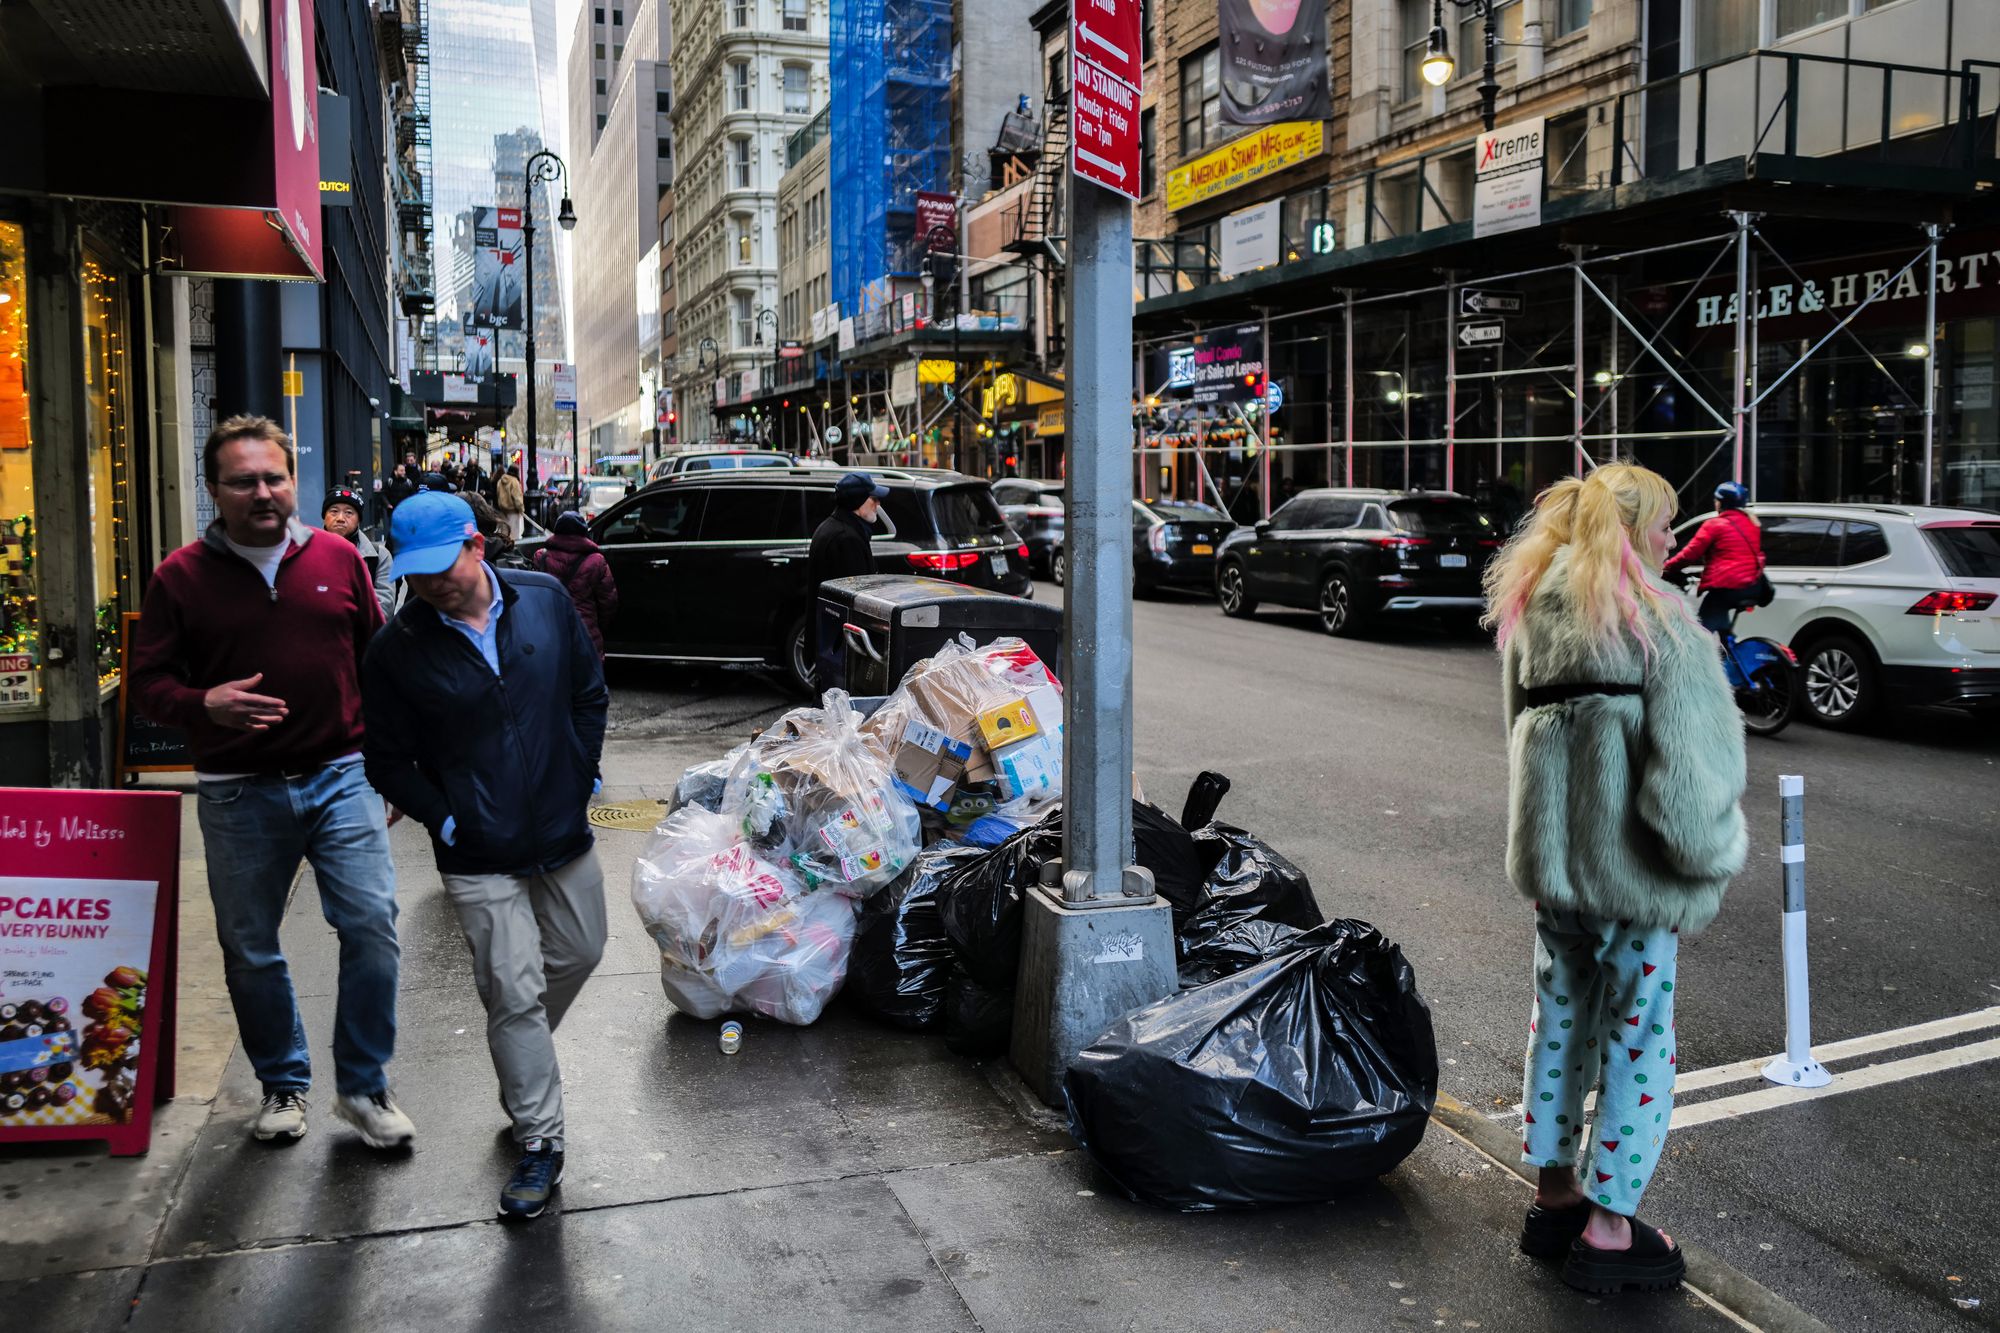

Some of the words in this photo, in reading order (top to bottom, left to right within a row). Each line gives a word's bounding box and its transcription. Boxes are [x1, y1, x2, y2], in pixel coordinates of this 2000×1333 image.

[1077, 60, 1090, 87] NO
[1092, 69, 1132, 111] STANDING
[1077, 90, 1103, 124] Monday
[1109, 107, 1128, 136] Friday
[1077, 113, 1092, 137] 7am
[1098, 123, 1112, 147] 7pm
[1191, 158, 1230, 189] AMERICAN
[1231, 147, 1259, 172] STAMP
[1260, 132, 1281, 160] MFG
[1480, 132, 1539, 169] Xtreme
[1247, 163, 1265, 177] STAMP
[318, 181, 350, 192] DUTCH
[918, 199, 956, 211] PAPAYA
[1472, 297, 1488, 307] ONE
[489, 312, 508, 328] bgc
[1464, 330, 1477, 340] ONE
[1483, 329, 1497, 337] WAY
[1194, 346, 1215, 364] Retail
[1215, 343, 1242, 361] Condo
[1195, 366, 1206, 382] For
[1207, 363, 1225, 380] Sale
[1225, 364, 1235, 377] or
[1235, 360, 1262, 377] Lease
[12, 690, 30, 701] Use
[34, 820, 51, 847] by
[59, 815, 125, 841] Melissa
